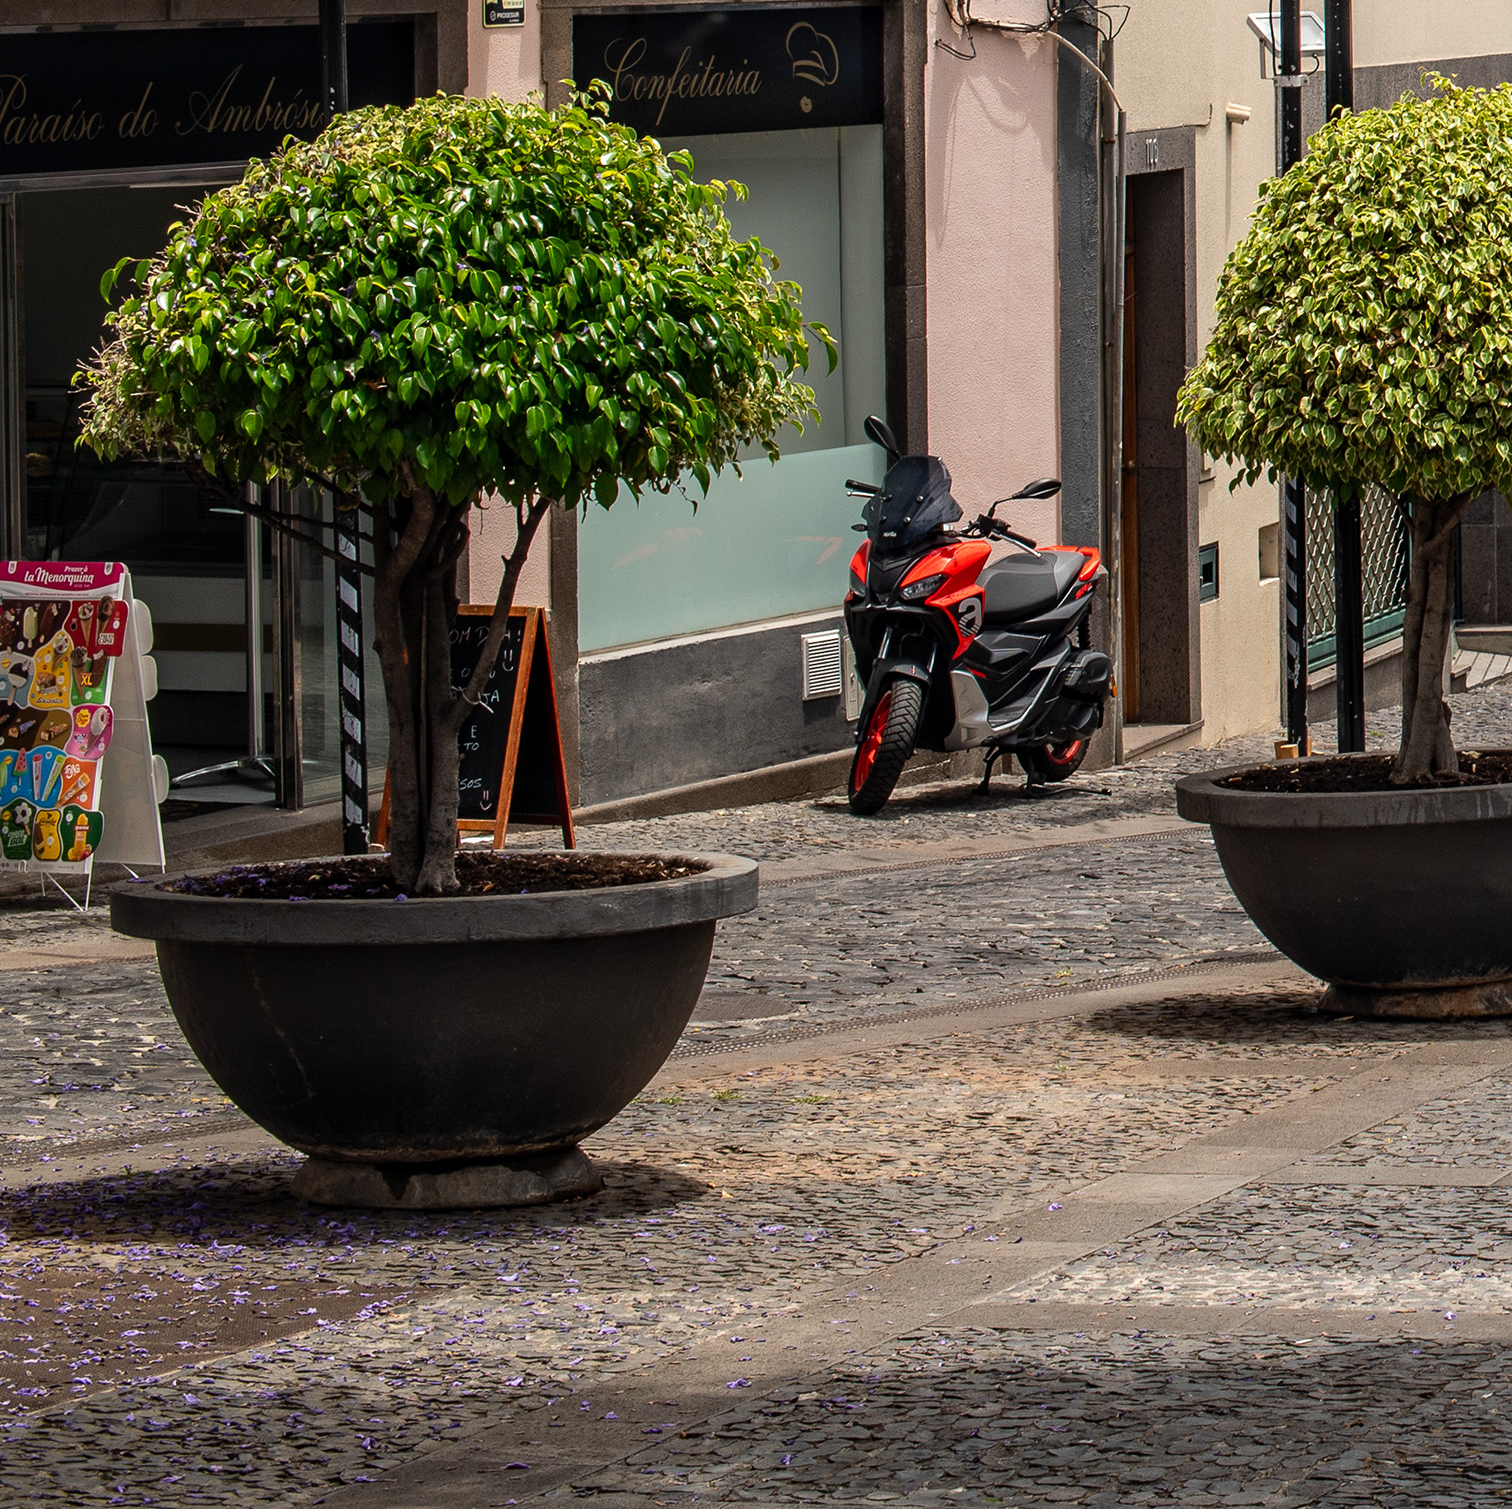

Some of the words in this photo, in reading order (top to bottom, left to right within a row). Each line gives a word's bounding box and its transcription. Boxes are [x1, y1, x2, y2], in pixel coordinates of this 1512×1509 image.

[0, 74, 104, 144] Paraíso
[119, 81, 158, 137] do
[175, 63, 324, 136] Ambrósi
[604, 38, 762, 126] Confeitaria
[35, 567, 95, 587] Menorquina
[81, 674, 92, 686] XL
